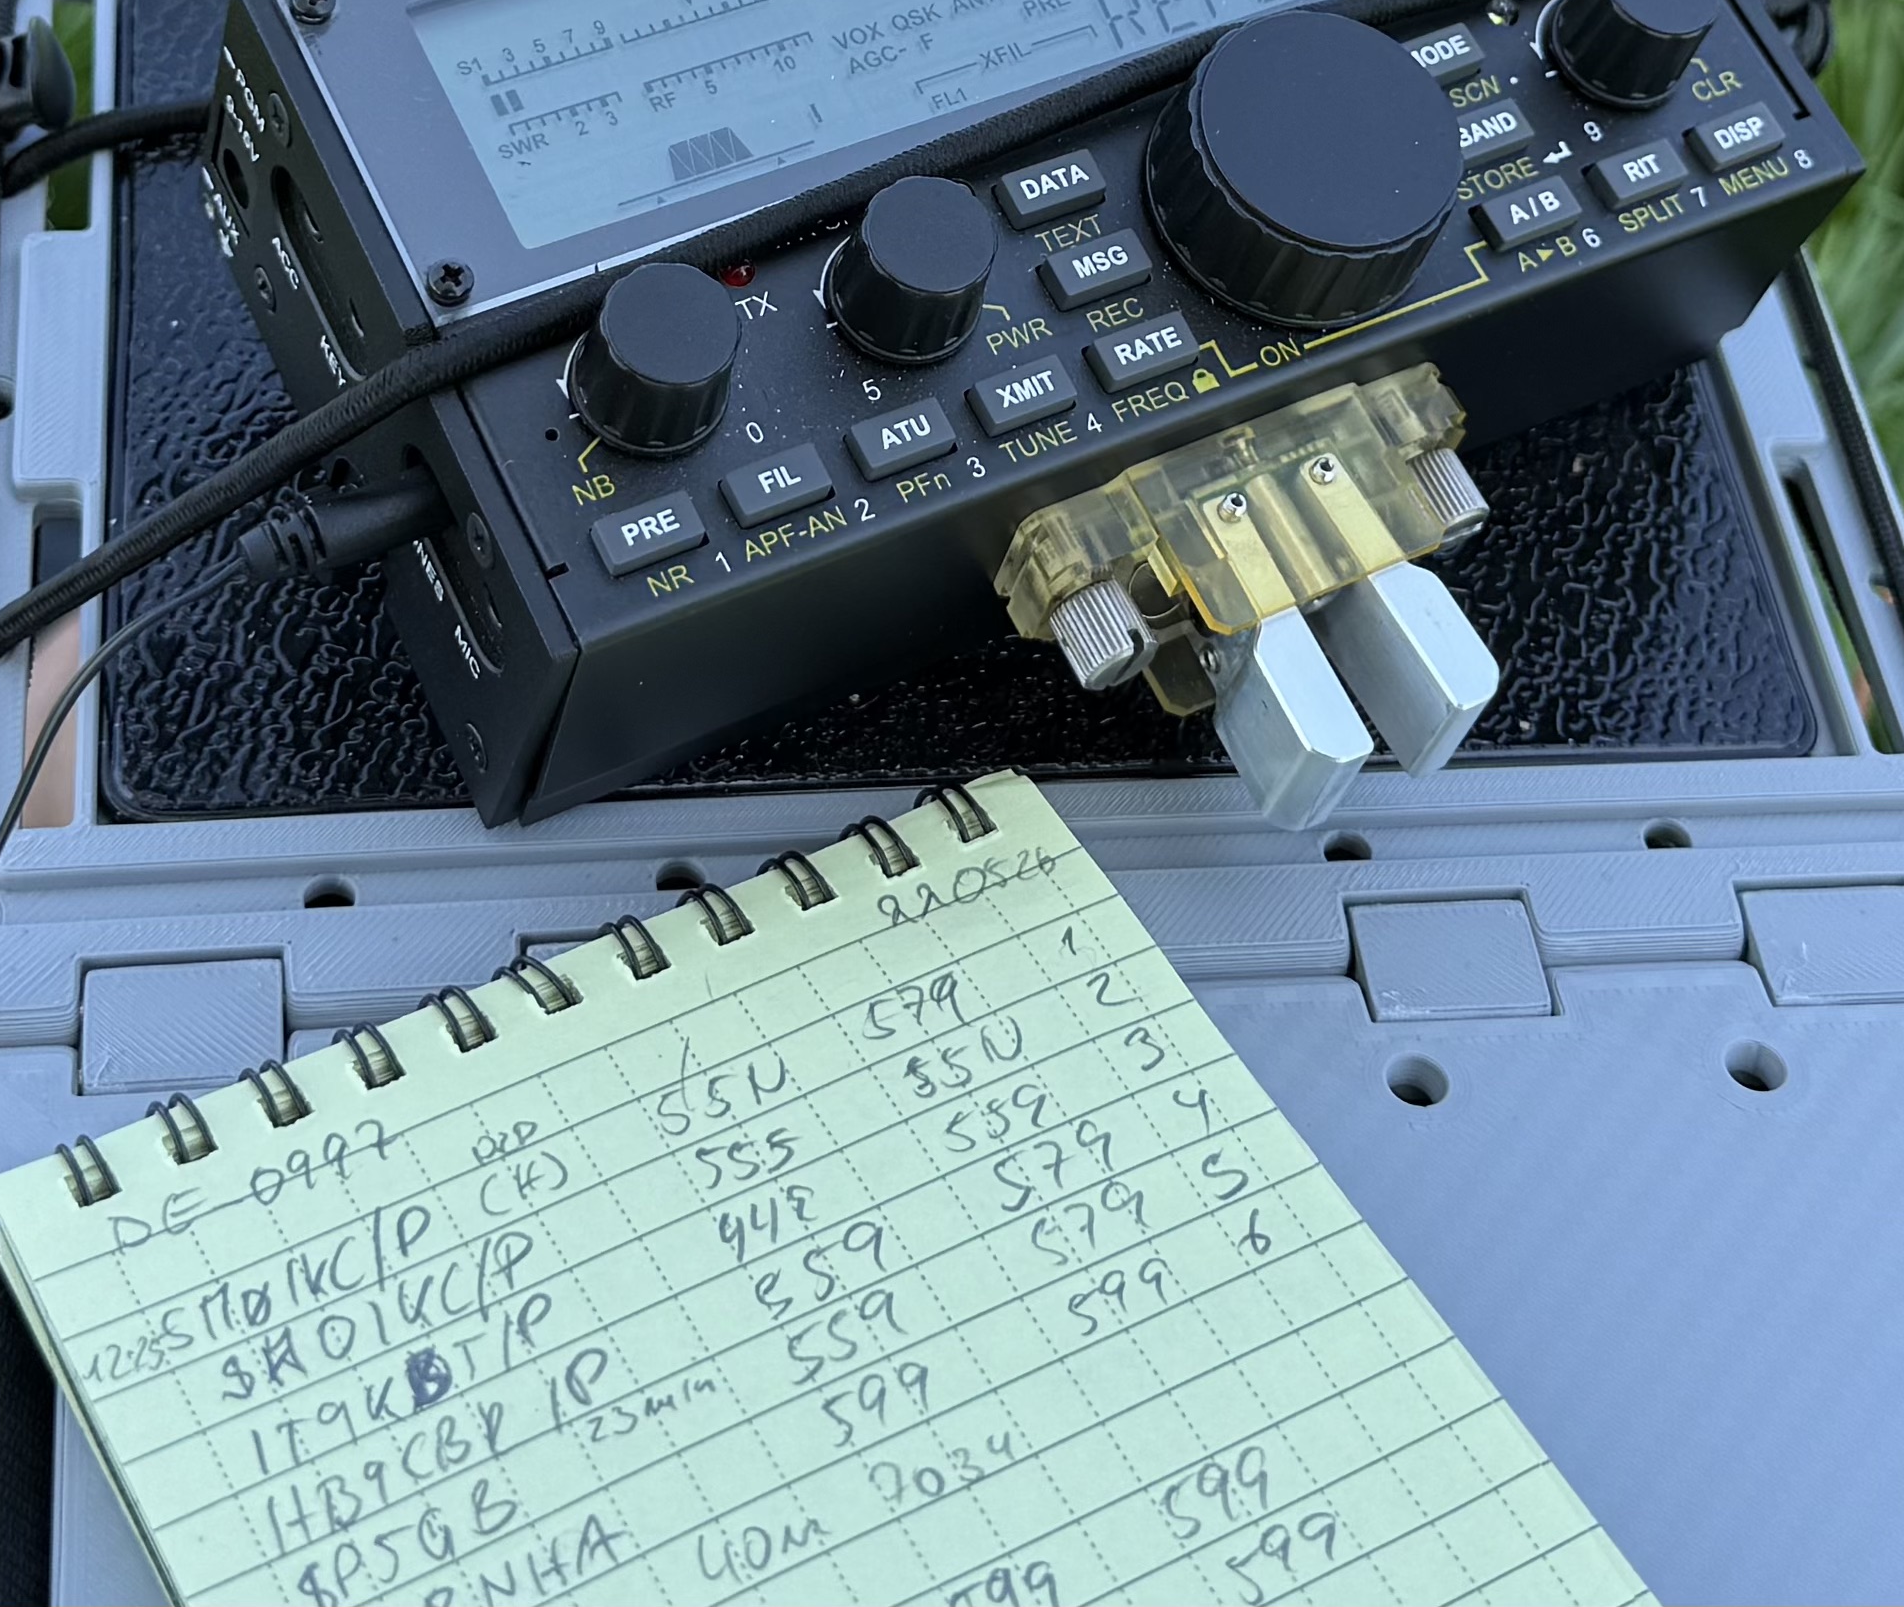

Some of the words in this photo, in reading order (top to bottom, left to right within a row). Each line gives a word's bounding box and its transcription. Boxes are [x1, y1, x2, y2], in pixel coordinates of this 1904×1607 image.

[832, 21, 885, 50] VOX
[891, 3, 943, 31] QSK
[457, 56, 483, 76] S1
[502, 47, 515, 63] 3
[533, 38, 546, 54] 5
[563, 28, 574, 44] 7
[593, 20, 606, 35] 9
[980, 41, 1032, 70] XFIL
[649, 92, 677, 112] RF
[704, 80, 718, 96] 5
[774, 54, 797, 74] 10
[1449, 76, 1500, 108] SCN
[1691, 70, 1743, 102] CLR
[498, 133, 549, 160] SWR
[575, 120, 589, 136] 2
[606, 110, 619, 126] 3
[1584, 120, 1604, 142] 9
[1713, 115, 1765, 150] DISP
[1020, 164, 1090, 200] DATA
[1623, 153, 1662, 183] RIT
[1718, 156, 1790, 197] MENU
[1793, 149, 1815, 171] 8
[1618, 193, 1686, 234] SPLIT
[1690, 186, 1709, 209] 7
[1035, 214, 1102, 252] TEXT
[1581, 227, 1601, 249] 6
[1072, 245, 1129, 279] MSG
[735, 291, 778, 320] TX
[1086, 297, 1144, 333] REC
[986, 317, 1053, 355] PWR
[1114, 326, 1183, 365] RATE
[1260, 338, 1301, 368] ON
[862, 379, 882, 401] 5
[996, 370, 1056, 408] XMIT
[1111, 381, 1190, 422] FREQ
[881, 414, 932, 450] ATU
[999, 420, 1078, 464] TUNE
[1087, 412, 1103, 433] 4
[571, 474, 616, 506] NB
[757, 464, 802, 493] FIL
[896, 472, 952, 503] PFn
[967, 456, 987, 479] 3
[621, 508, 681, 546] PRE
[744, 505, 848, 562] APF-AN
[854, 498, 876, 522] 2
[646, 565, 694, 597] NR
[715, 550, 732, 573] 1
[454, 624, 481, 680] MIC
[1061, 925, 1077, 956] 1
[1086, 971, 1144, 1007] 2
[1124, 1026, 1166, 1072] 3
[994, 1118, 1115, 1212] 579
[1173, 1088, 1211, 1134] 4
[1031, 1180, 1152, 1267] 579
[1201, 1148, 1249, 1200] 5
[820, 1361, 929, 1448] 599
[1068, 1257, 1169, 1337] 599
[1237, 1208, 1272, 1255] 6
[1159, 1444, 1270, 1541] 599
[1226, 1510, 1338, 1606] 599
